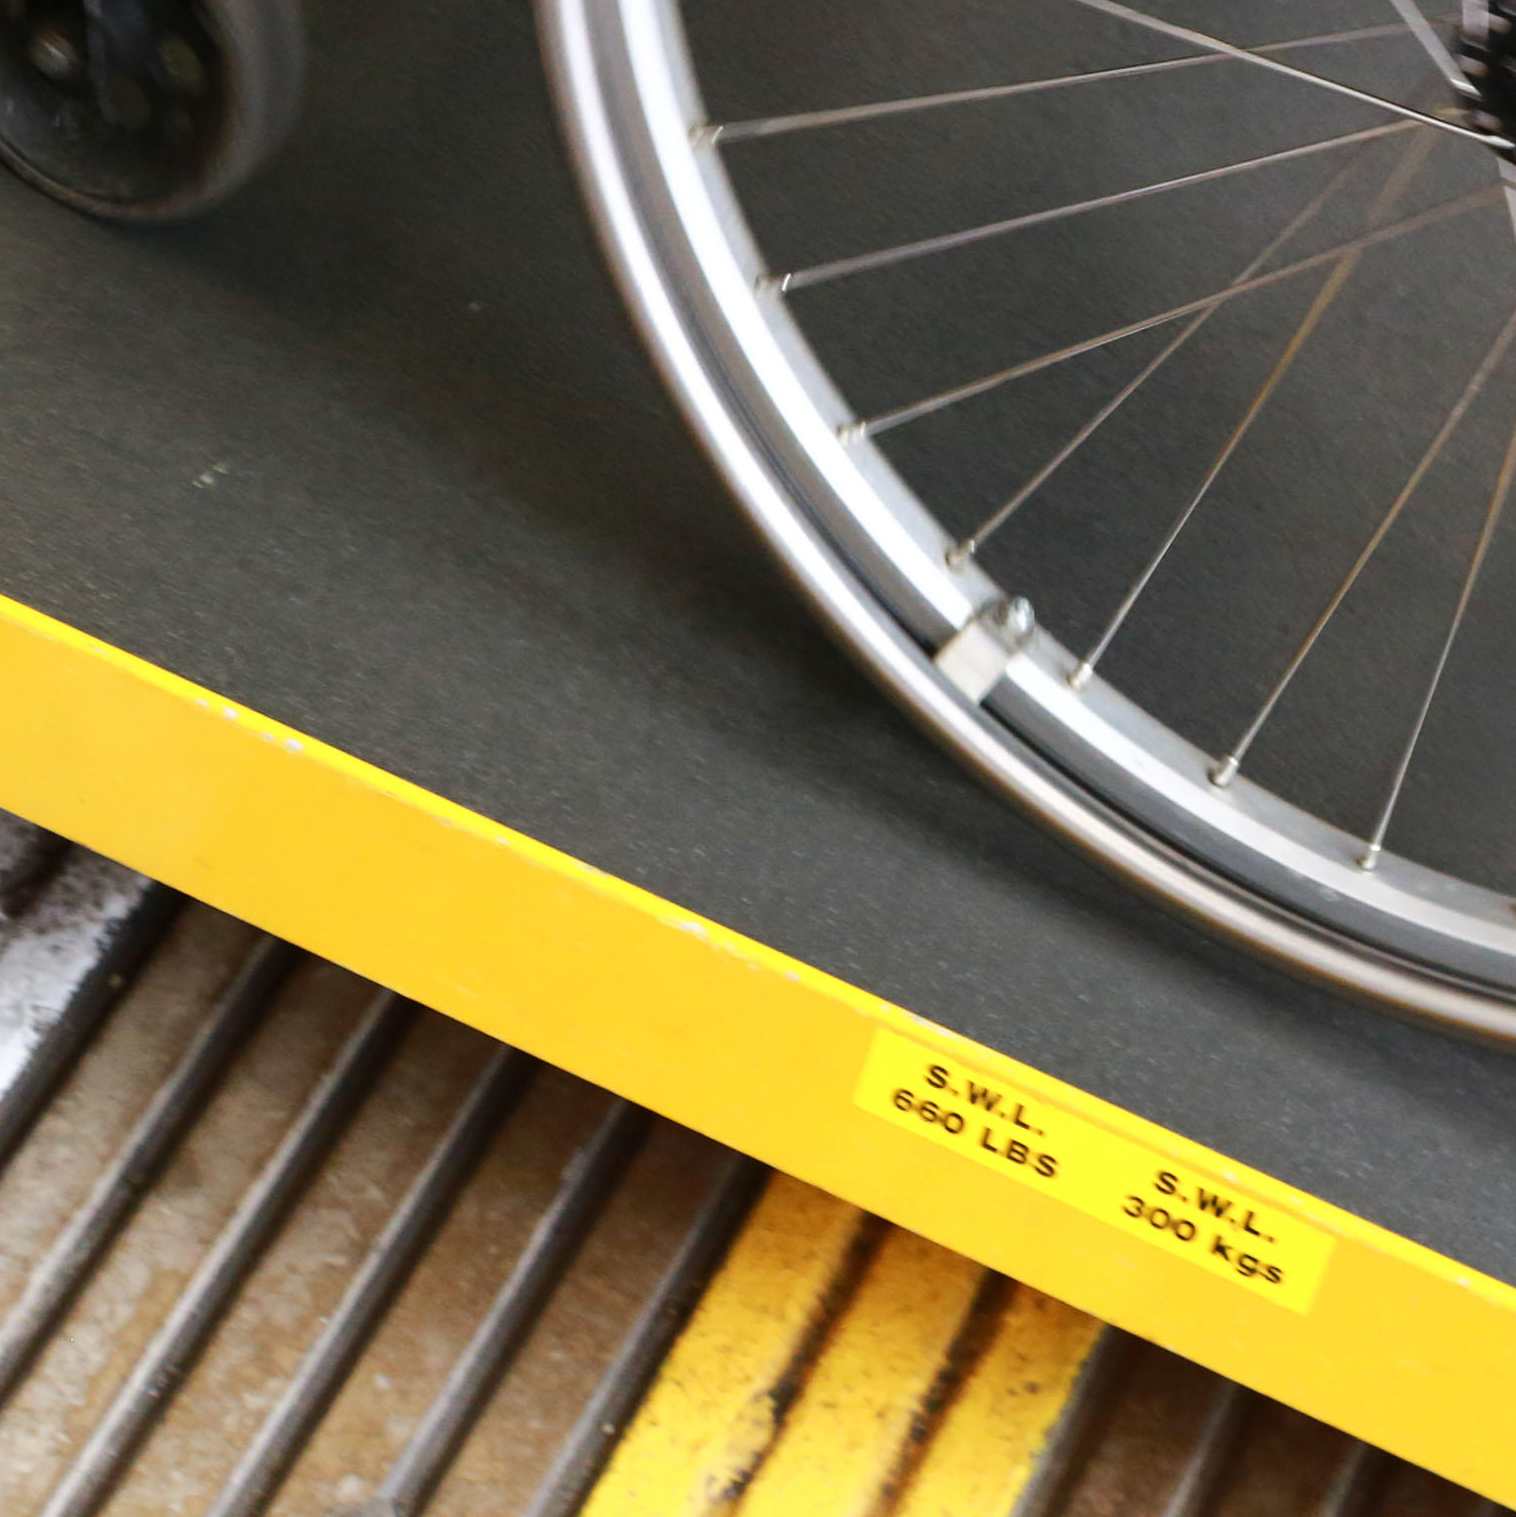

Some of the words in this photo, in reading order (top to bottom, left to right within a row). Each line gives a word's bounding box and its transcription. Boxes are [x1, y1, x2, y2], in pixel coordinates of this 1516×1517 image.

[893, 1089, 965, 1135] 660
[979, 1127, 1059, 1178] LBS
[925, 1064, 1044, 1136] S.W.L.
[1122, 1195, 1196, 1242] 300
[1210, 1235, 1285, 1285] kgs
[1154, 1170, 1275, 1242] S.W.L.
